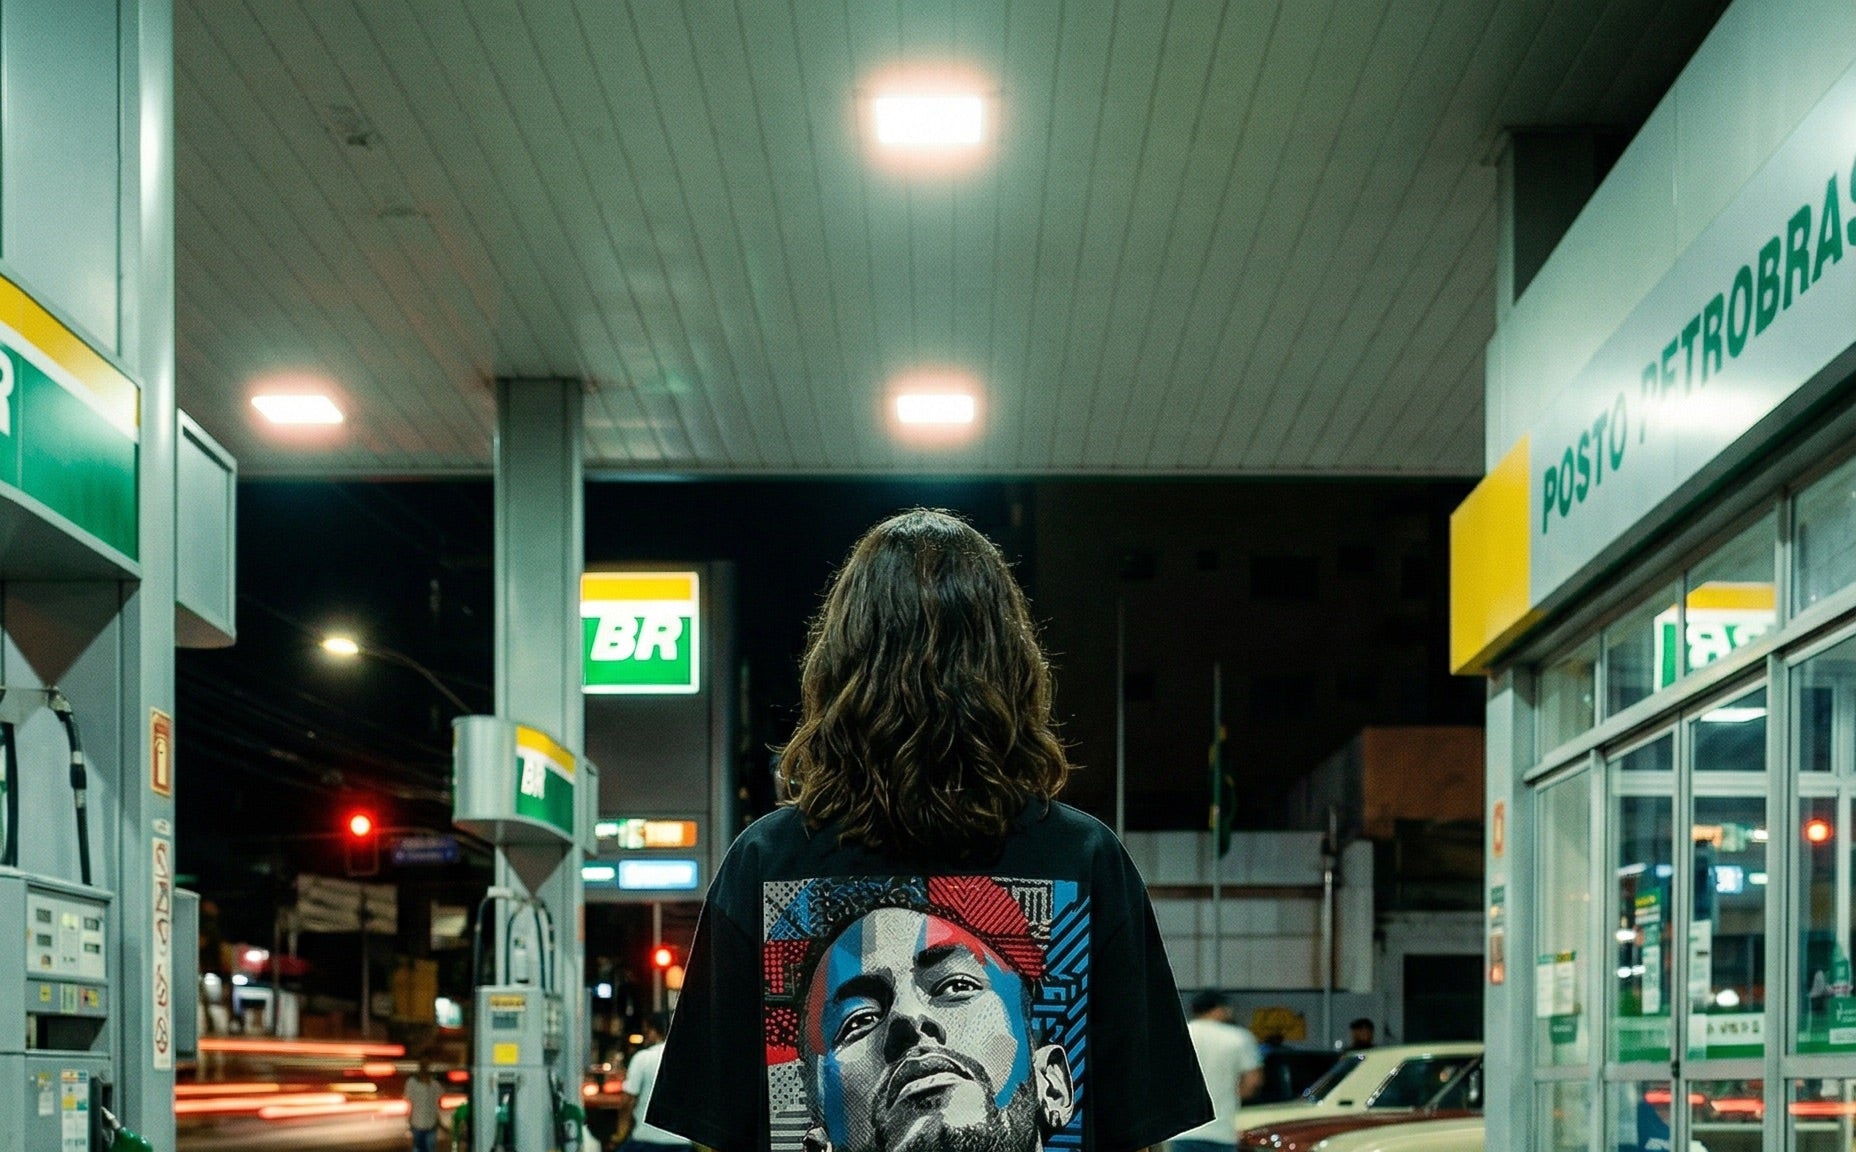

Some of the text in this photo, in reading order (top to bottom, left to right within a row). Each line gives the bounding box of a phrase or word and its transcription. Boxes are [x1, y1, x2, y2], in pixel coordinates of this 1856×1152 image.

[1542, 391, 1627, 535] POSTO
[590, 614, 683, 661] BR
[520, 757, 547, 800] BR
